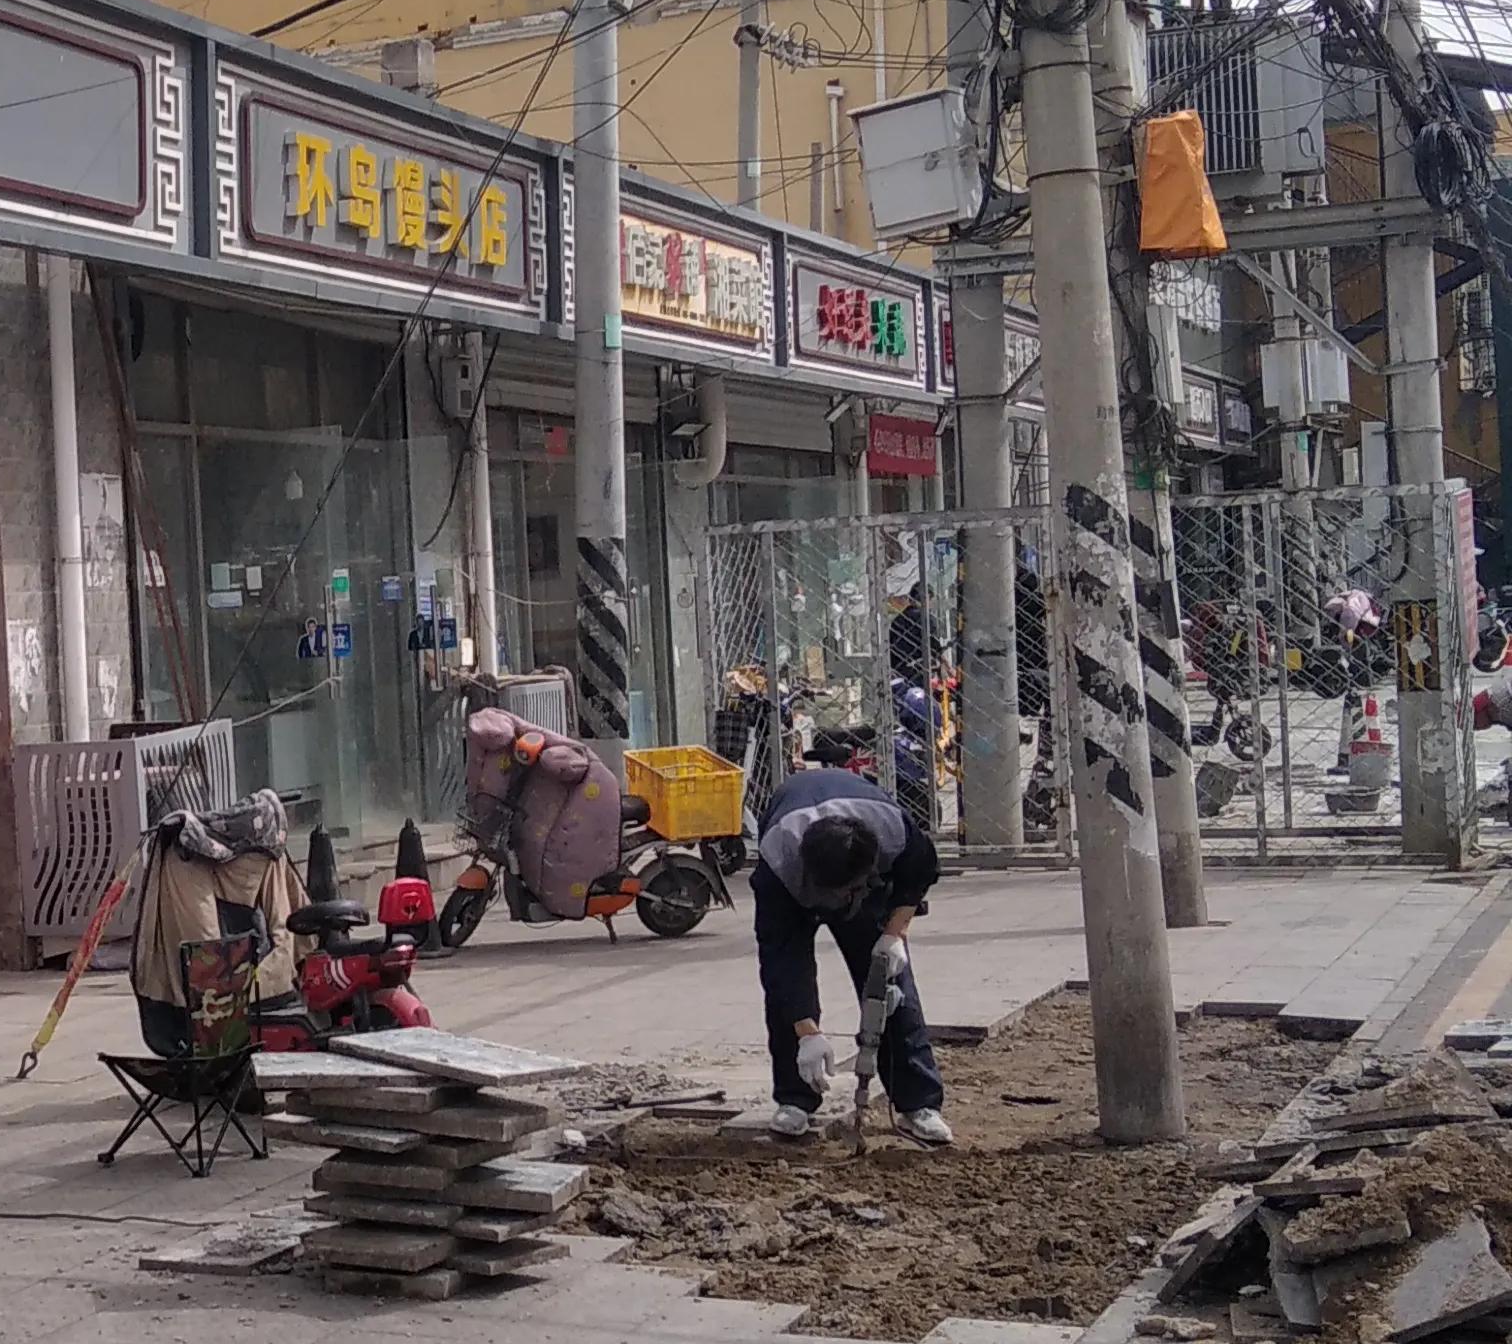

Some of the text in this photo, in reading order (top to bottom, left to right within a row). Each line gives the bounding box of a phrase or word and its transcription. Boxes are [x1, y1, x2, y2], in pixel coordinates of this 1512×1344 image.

[286, 131, 506, 266] 环岛馒头店
